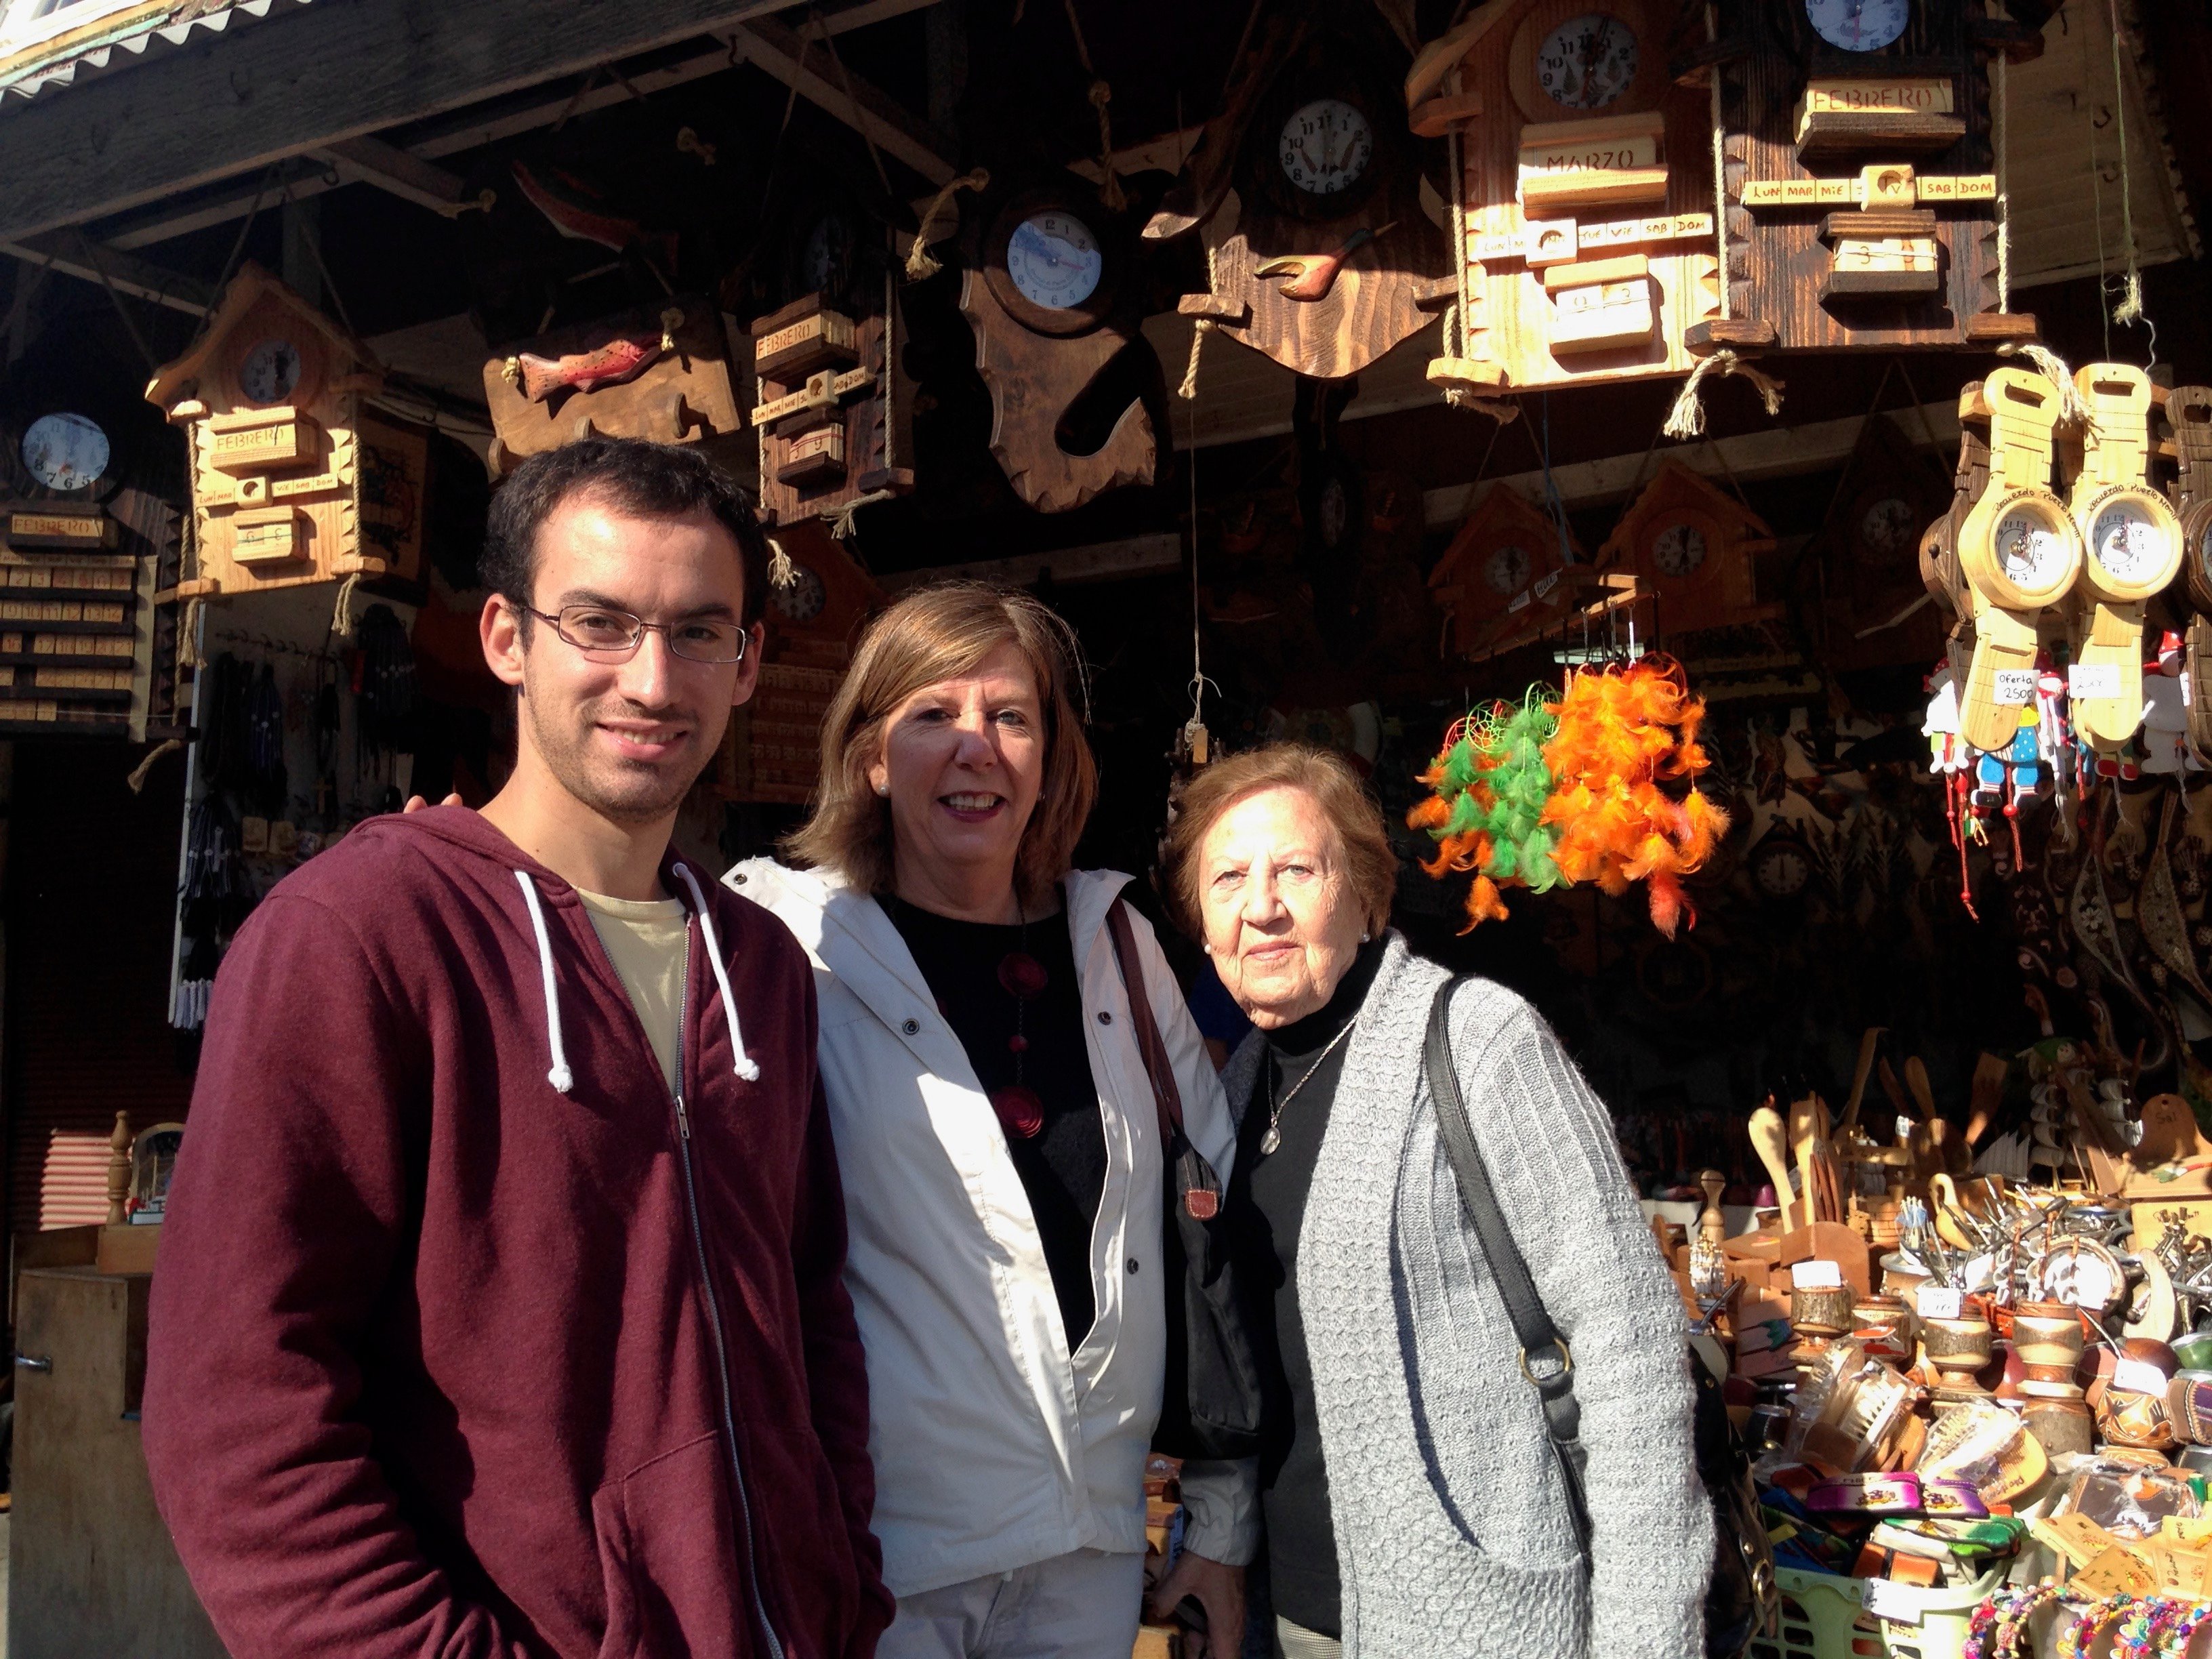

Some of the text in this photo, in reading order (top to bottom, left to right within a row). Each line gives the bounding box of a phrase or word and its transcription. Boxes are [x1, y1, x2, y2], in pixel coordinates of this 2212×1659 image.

[1561, 41, 1573, 54] 11
[1547, 57, 1563, 68] 10
[1542, 73, 1553, 86] 9
[1814, 88, 1931, 109] FEBRERO
[1302, 122, 1313, 135] 11
[1288, 138, 1304, 149] 10
[1285, 152, 1294, 165] 9
[1547, 150, 1634, 171] MARZO
[1293, 169, 1302, 181] 8
[1325, 181, 1334, 193] 6
[1788, 186, 1813, 197] MAR
[1927, 184, 1951, 193] SAB
[1045, 219, 1056, 230] 12
[1065, 224, 1070, 235] 1
[1485, 242, 1505, 252] LUN
[1580, 231, 1601, 240] JUE
[1646, 224, 1668, 234] SAB
[1677, 221, 1705, 232] DOM
[1012, 255, 1019, 266] 9
[1018, 274, 1025, 285] 8
[1033, 289, 1038, 299] 7
[1051, 295, 1058, 305] 6
[1069, 289, 1076, 300] 5
[758, 324, 810, 356] FEBRERO
[849, 373, 865, 385] DOM
[217, 426, 284, 450] FEBRERO
[47, 472, 56, 483] 7
[64, 478, 73, 489] 6
[82, 476, 91, 485] 5
[200, 495, 214, 504] LUN
[316, 478, 333, 487] DOM
[2040, 491, 2067, 513] Puerto
[2087, 484, 2125, 512] Recuerdo
[2130, 483, 2158, 500] Puerto
[14, 518, 89, 533] FEBRERO
[1999, 674, 2032, 685] Oferta
[2004, 687, 2033, 699] 2500
